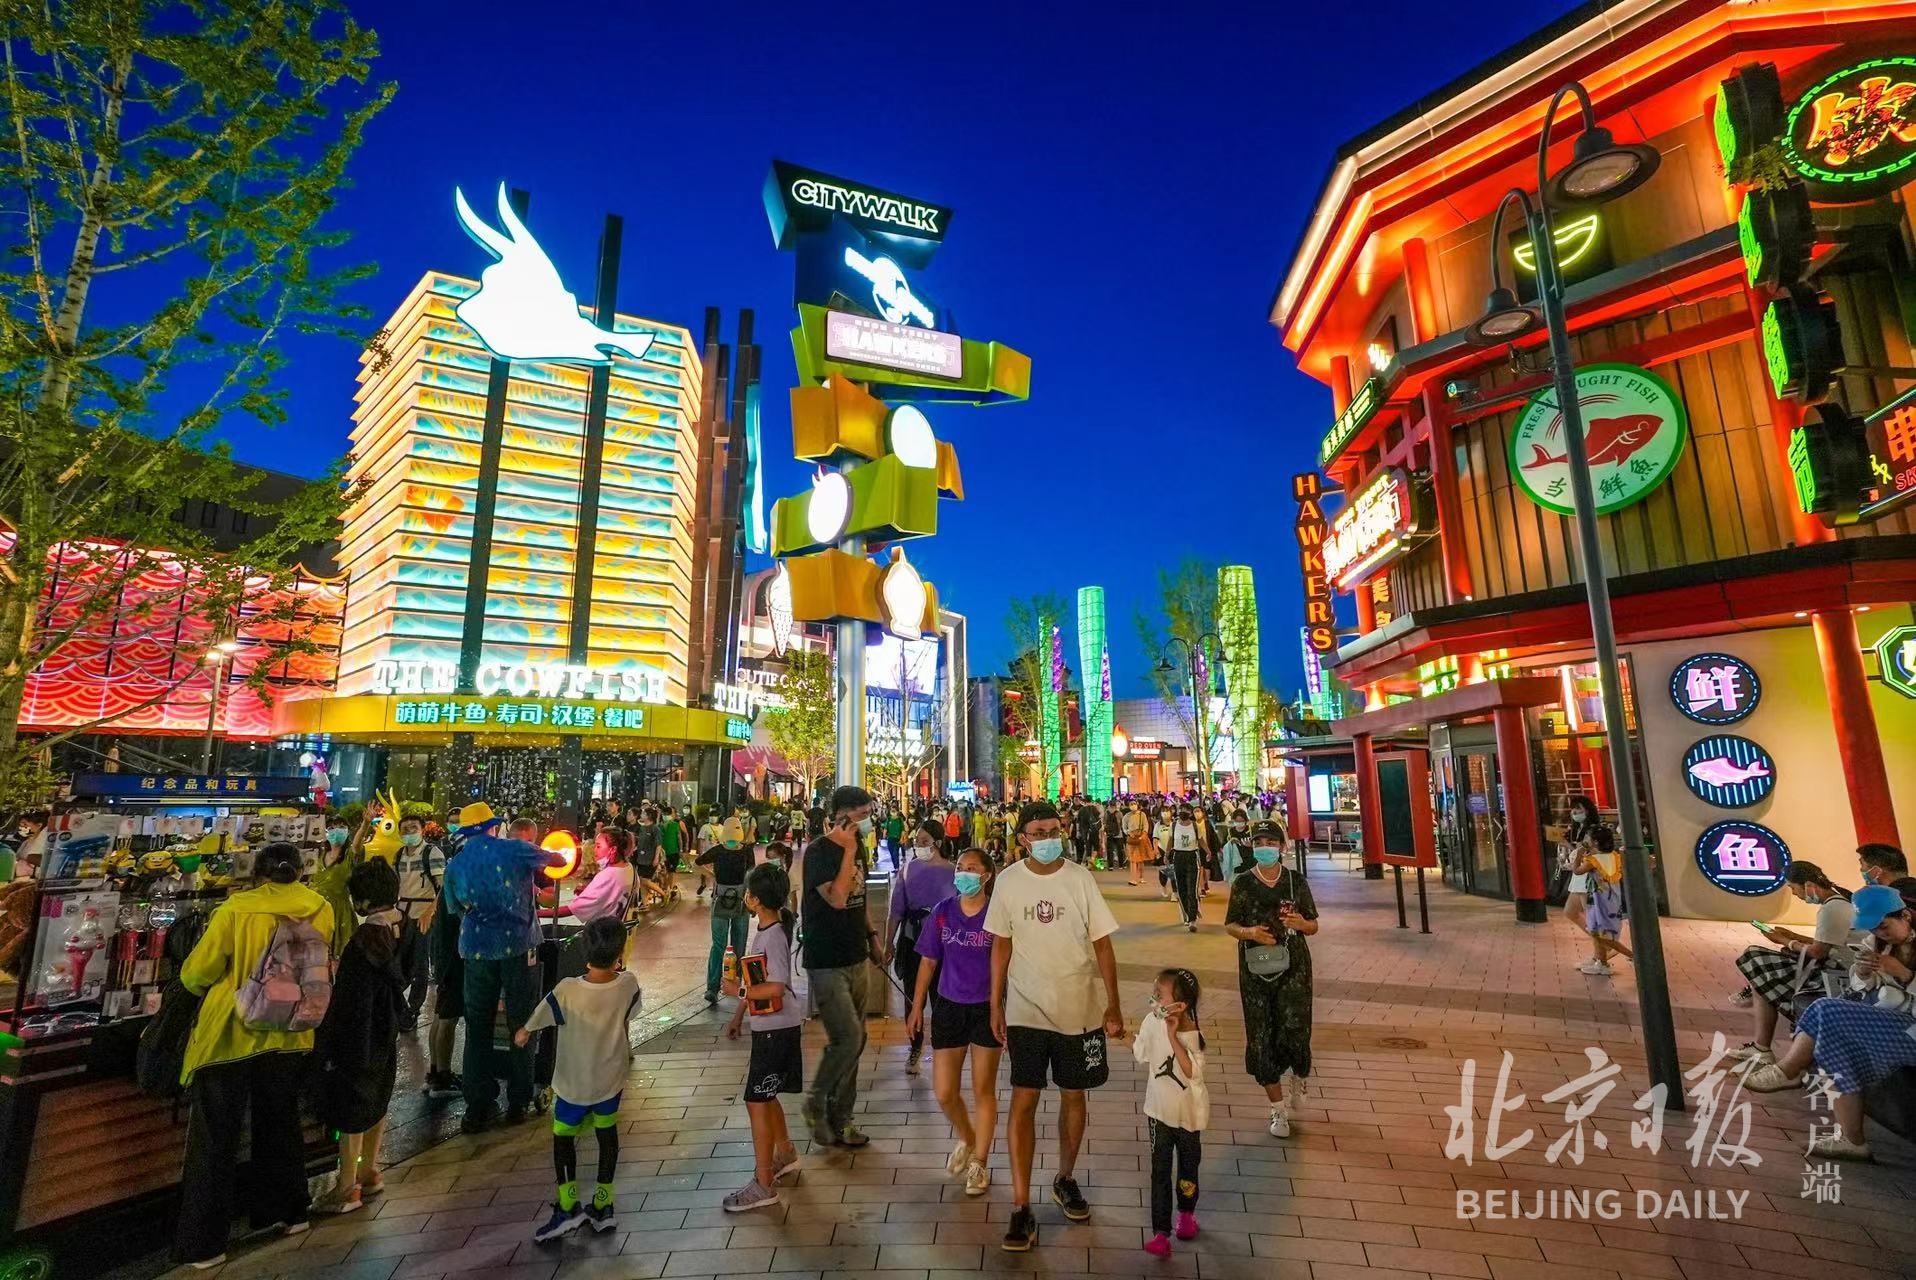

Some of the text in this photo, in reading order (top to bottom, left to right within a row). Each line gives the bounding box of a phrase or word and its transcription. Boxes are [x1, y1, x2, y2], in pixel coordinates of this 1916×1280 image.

[792, 179, 939, 233] CITYWALK
[1577, 375, 1622, 388] UGHT
[1626, 379, 1660, 405] FISH
[1544, 459, 1660, 499] 当鮮魚
[1296, 475, 1332, 651] HAWKERS
[373, 659, 668, 705] THE COWFISH
[141, 777, 257, 791] 纪念品和玩具
[1686, 665, 1776, 880] 鲜 鱼
